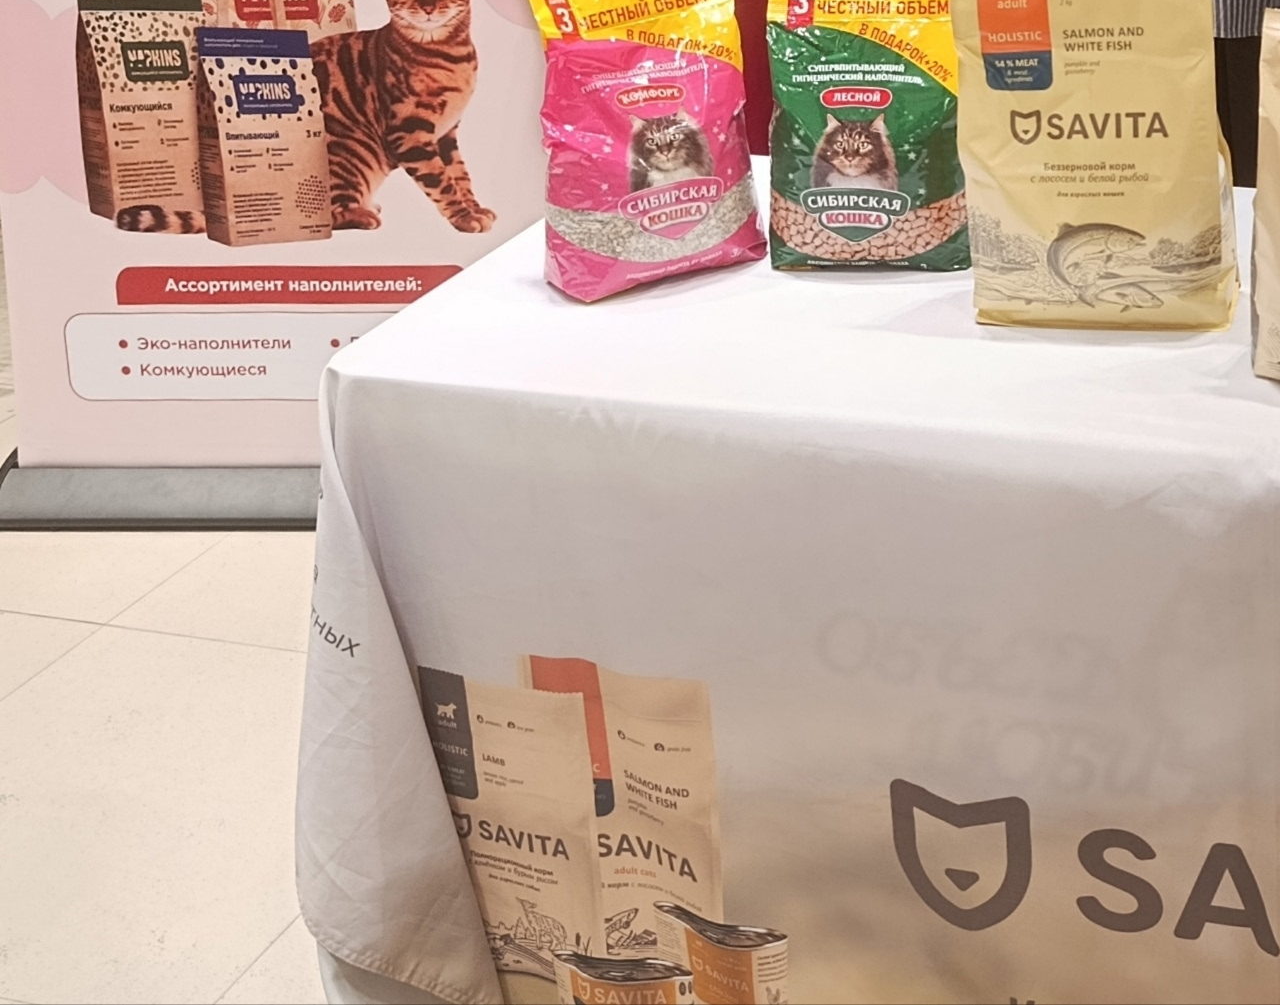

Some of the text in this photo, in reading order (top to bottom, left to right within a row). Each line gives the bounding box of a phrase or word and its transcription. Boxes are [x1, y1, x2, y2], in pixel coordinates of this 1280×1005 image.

[556, 8, 574, 33] 3
[626, 29, 634, 41] В
[859, 23, 869, 35] В
[988, 31, 1043, 42] HOLISTIC
[1063, 27, 1144, 39] SALMON AND
[1064, 41, 1132, 52] WHITE FISH
[833, 91, 881, 102] ЛЕСНОЙ
[109, 102, 173, 113] Комкующийся
[1047, 112, 1169, 140] SAVITA
[1044, 162, 1135, 173] Беззерновой корм
[1088, 173, 1116, 182] белой
[1119, 173, 1149, 184] рыбой
[627, 185, 717, 214] СИБИРСКАЯ
[808, 196, 901, 211] СИБИРСКАЯ
[648, 205, 703, 227] КОШКА
[825, 213, 883, 225] КОШКА
[165, 277, 422, 295] Ассортимент наполнителей:
[137, 336, 292, 351] Эко-наполнители
[140, 363, 266, 379] Комкующиеся
[482, 754, 505, 766] LAMB
[624, 770, 690, 798] SALMON AND
[625, 782, 677, 810] WHITE FISH
[478, 820, 570, 861] SAVITA
[598, 833, 698, 883] SAVITA
[614, 866, 638, 875] adult
[594, 987, 668, 1005] SAVITA
